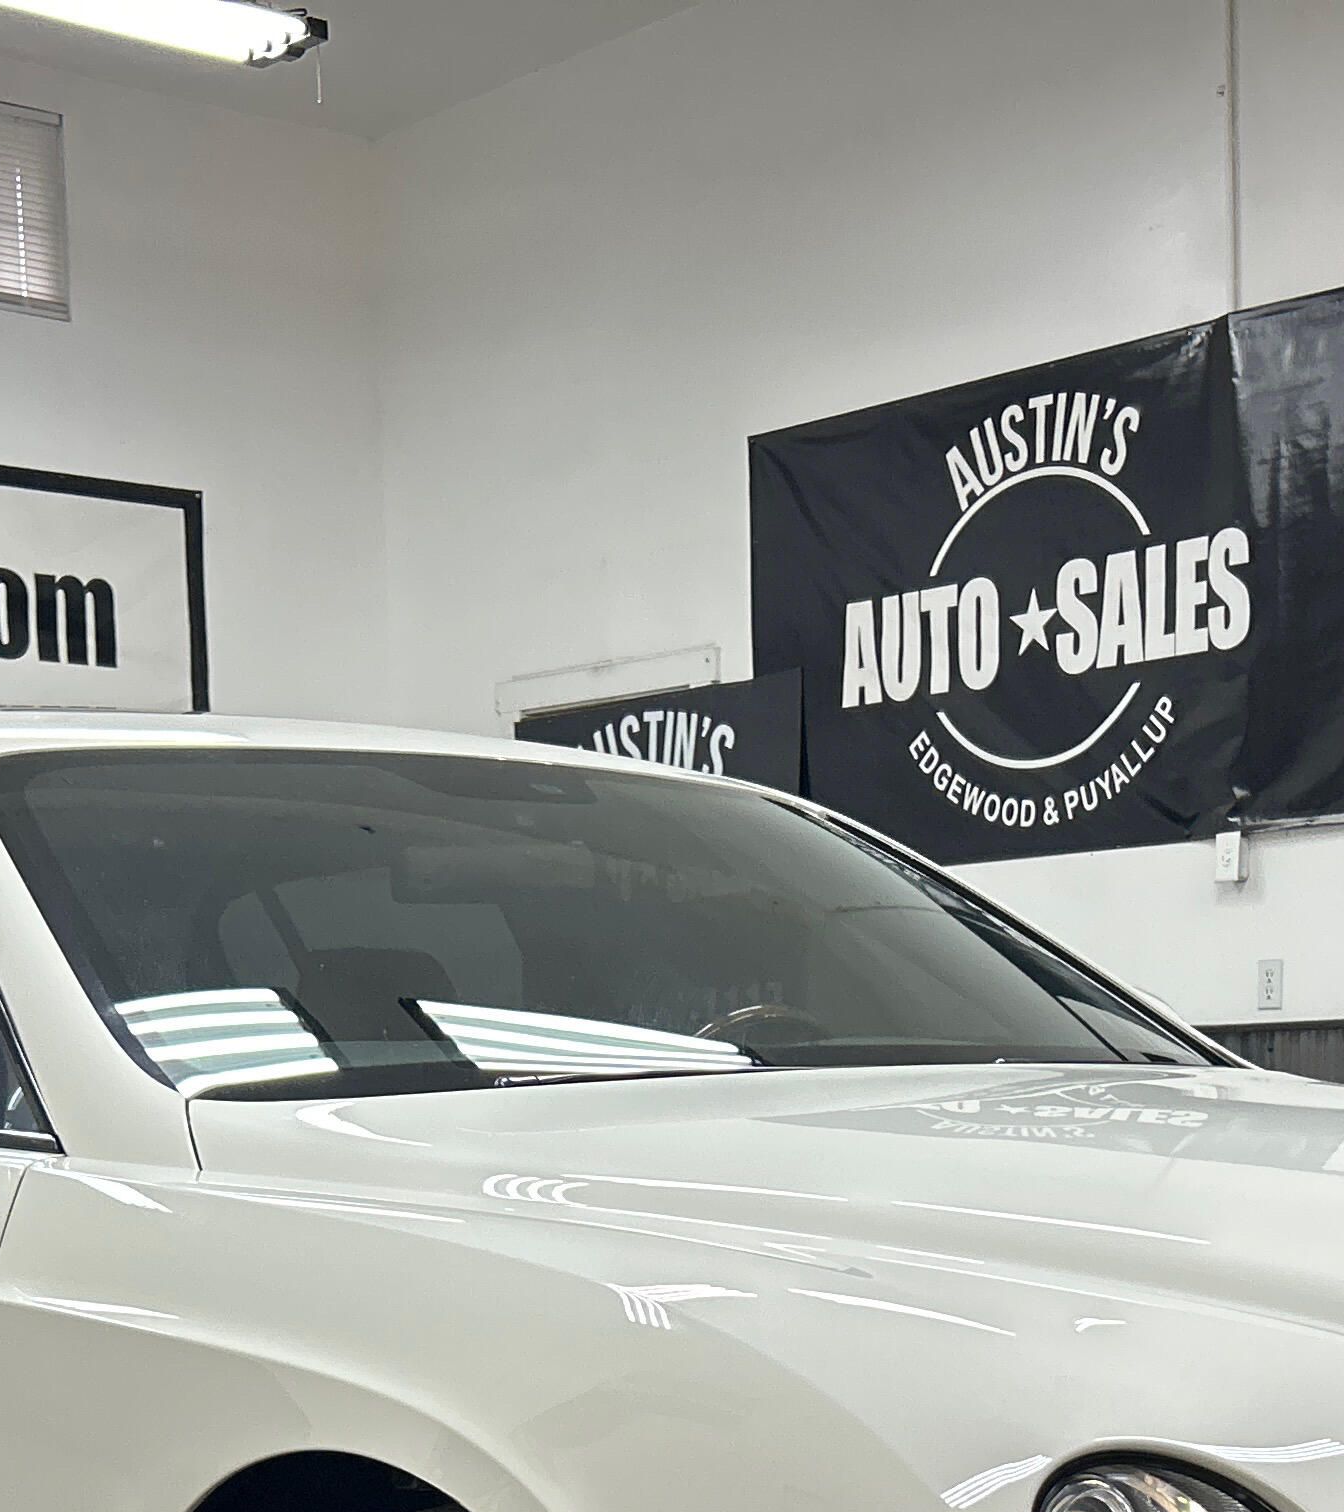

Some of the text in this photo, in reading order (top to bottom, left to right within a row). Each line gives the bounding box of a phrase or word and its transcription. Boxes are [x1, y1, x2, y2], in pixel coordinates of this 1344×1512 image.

[945, 391, 1141, 512] AUSTIN'S
[842, 526, 1251, 709] AUTO SALES
[577, 710, 736, 776] USTIN'S
[908, 695, 1176, 828] EDGEWOOD & PUYALLUP
